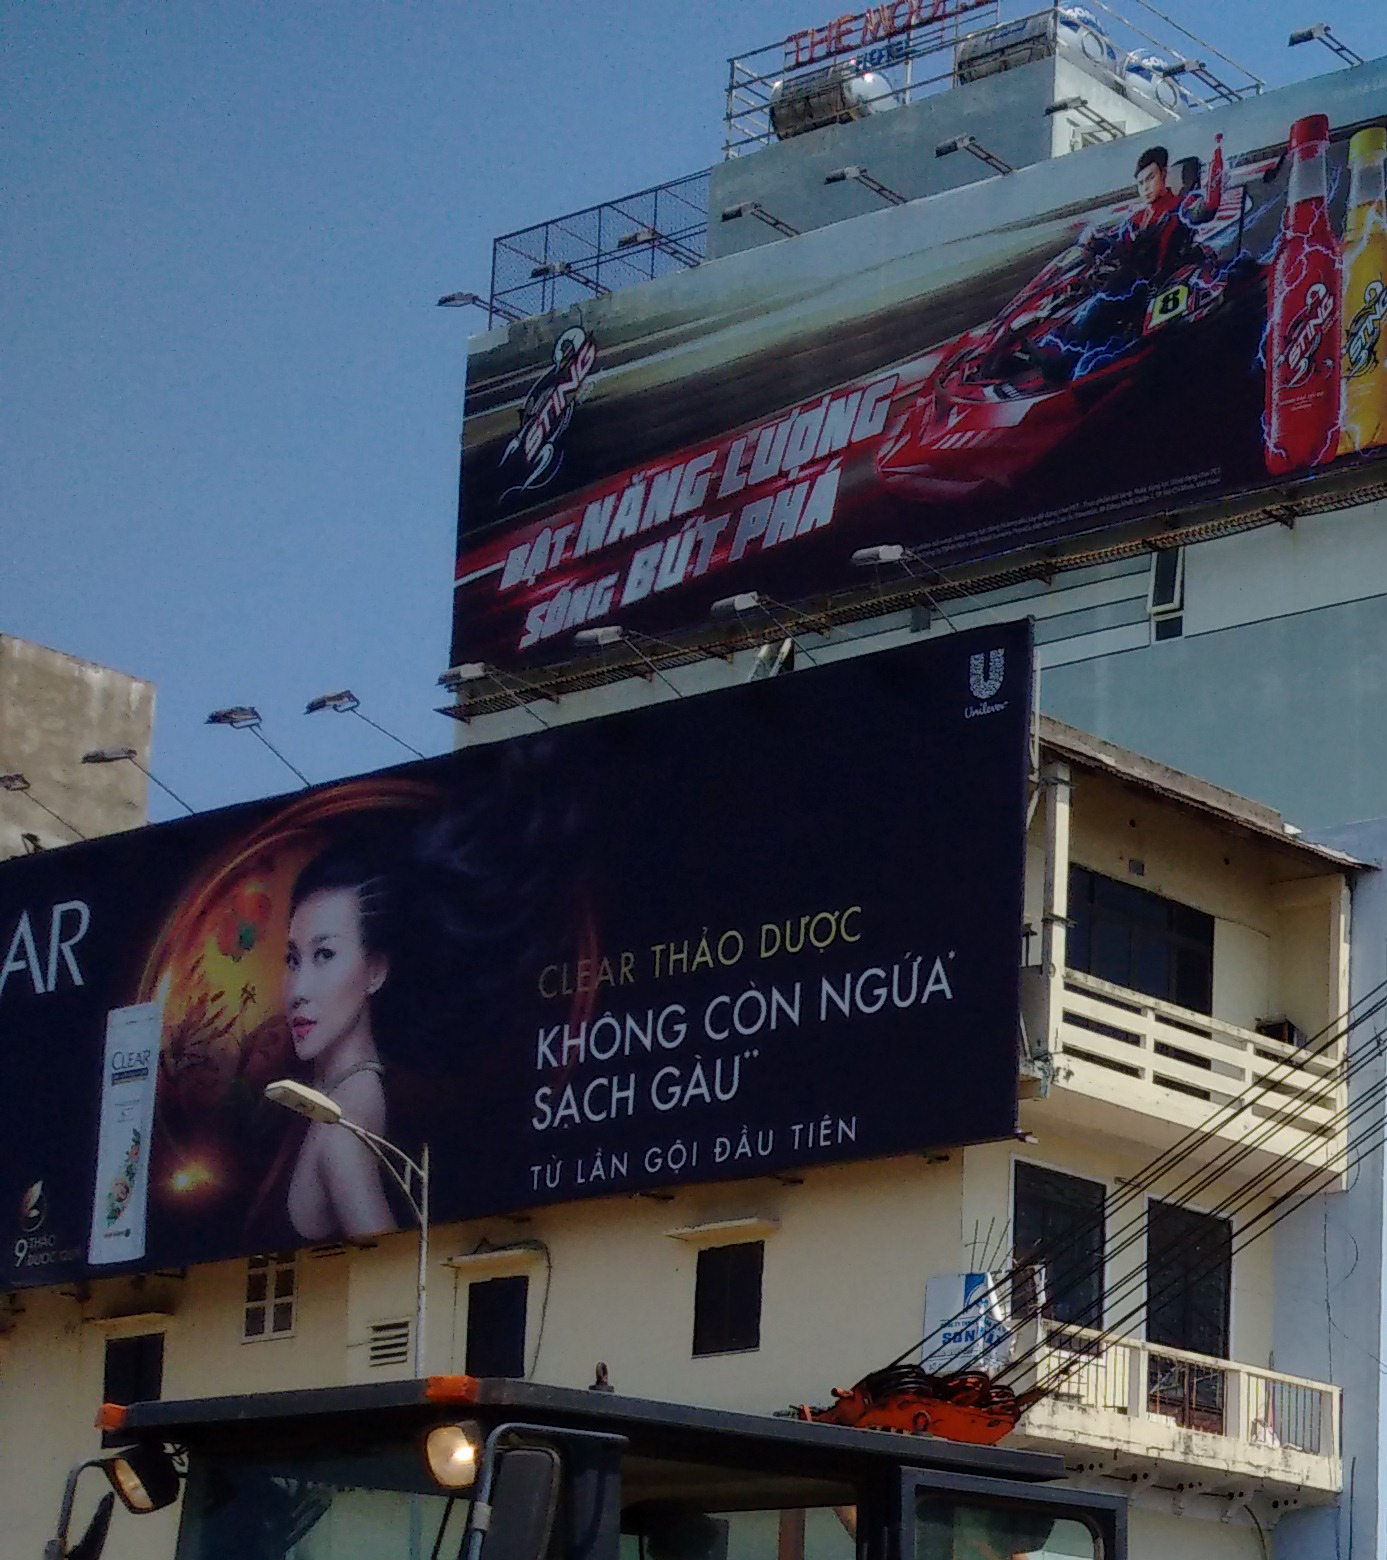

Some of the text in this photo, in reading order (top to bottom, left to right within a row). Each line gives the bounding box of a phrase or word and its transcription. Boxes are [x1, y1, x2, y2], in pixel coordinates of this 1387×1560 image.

[1159, 291, 1181, 315] 8
[1289, 293, 1335, 371] STING
[524, 339, 597, 465] STING
[573, 450, 718, 558] NĂNG
[718, 372, 901, 499] LƯỢNG
[727, 456, 844, 563] PHÁ
[964, 701, 1009, 719] Unilever
[538, 905, 863, 1000] CLEAR THẢO DƯỢC
[111, 1049, 151, 1072] CLEAR
[535, 1003, 688, 1071] KHÔNG
[705, 981, 802, 1041] CÒN
[532, 1071, 636, 1131] SẠCH
[529, 1114, 858, 1191] TỪ LẦN GỘI ĐẦU TIÊN
[14, 1237, 28, 1268] 9
